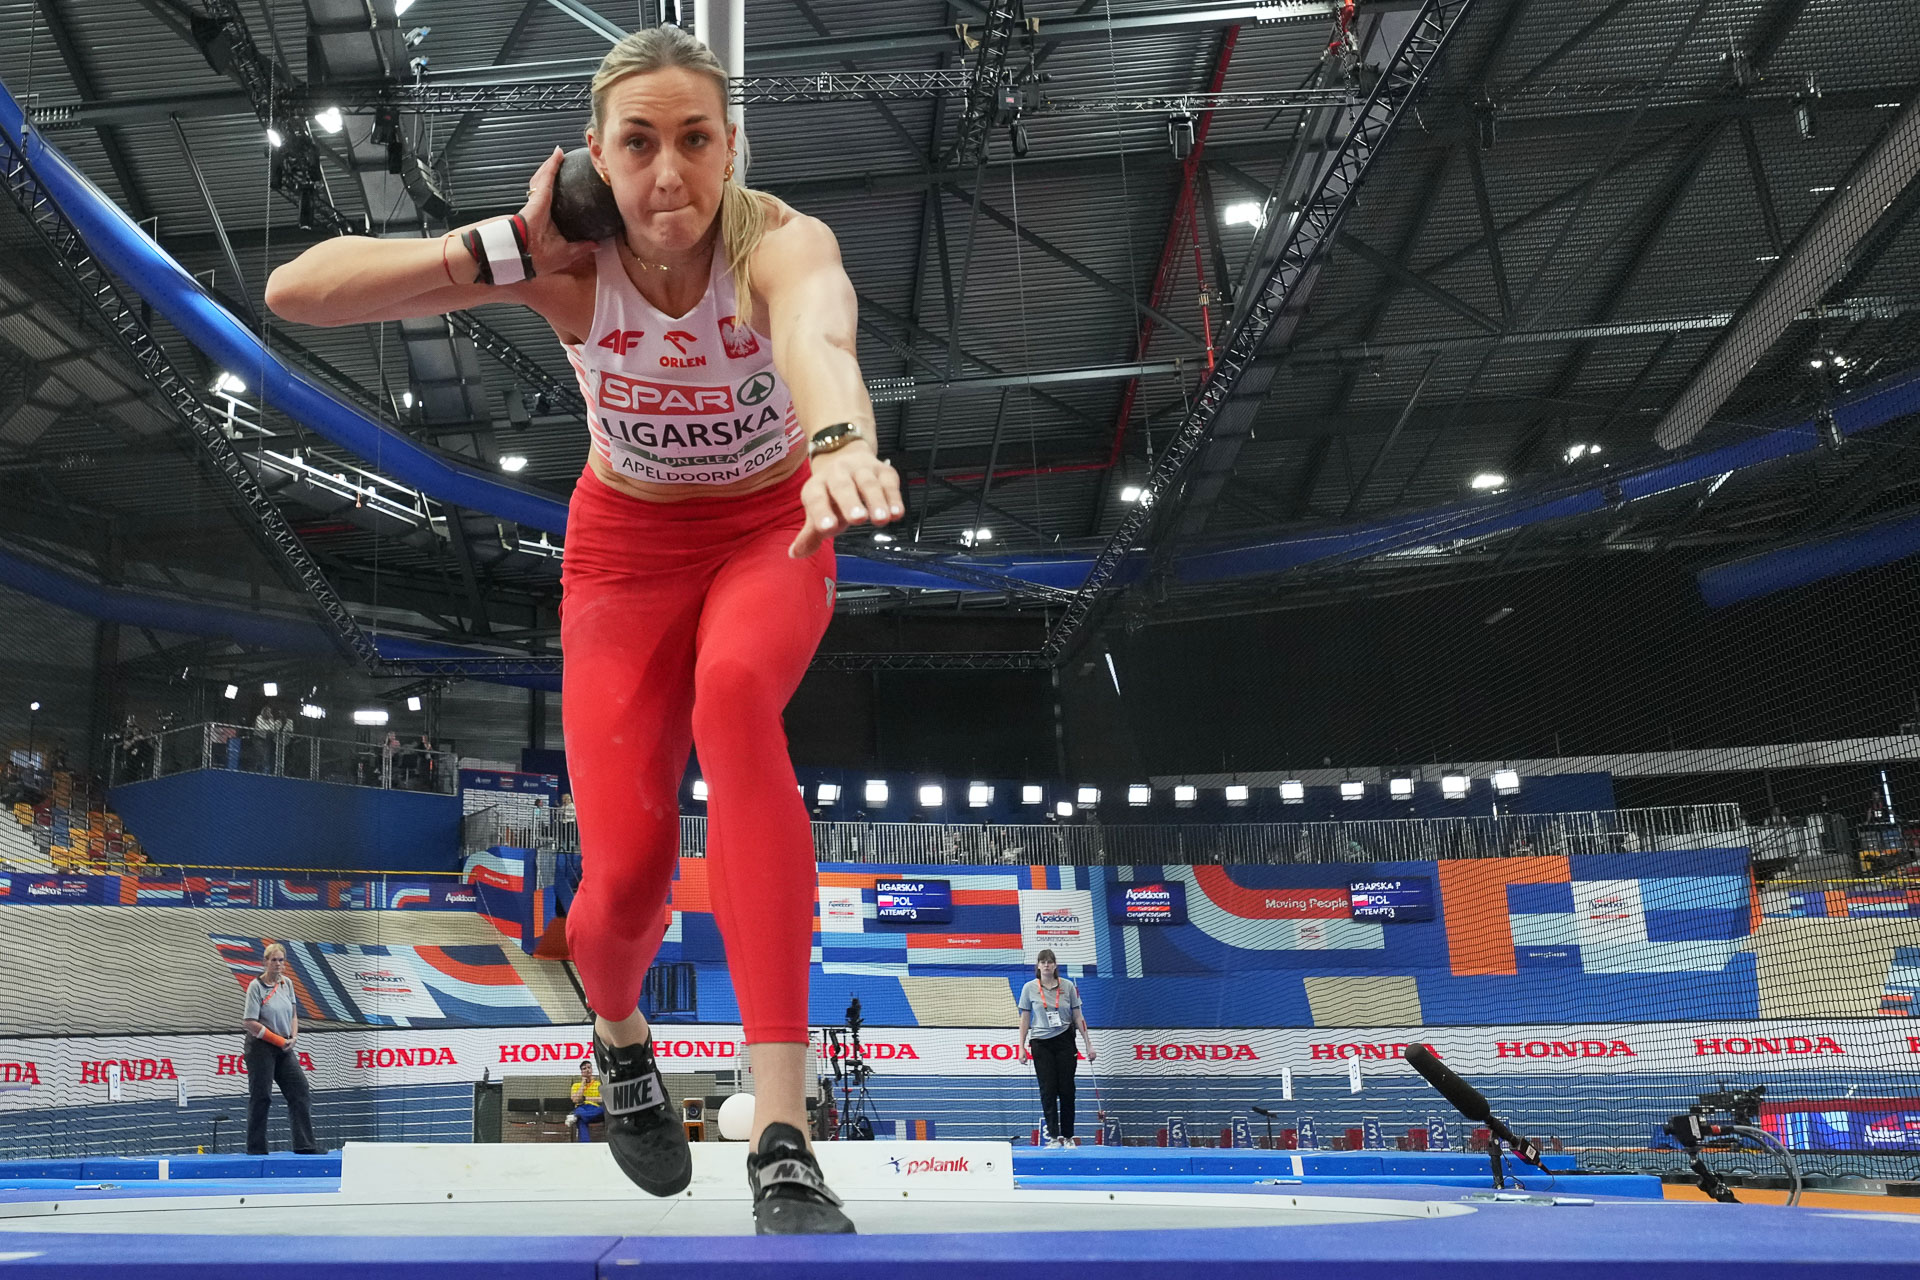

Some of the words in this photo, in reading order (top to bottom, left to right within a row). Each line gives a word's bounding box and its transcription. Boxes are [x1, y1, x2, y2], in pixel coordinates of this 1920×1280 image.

[659, 355, 707, 368] ORLEN
[602, 378, 730, 412] SPAR
[601, 405, 779, 449] LIGARSKA
[622, 457, 740, 482] APELDOORN
[743, 441, 784, 473] 2025
[876, 883, 918, 892] LIGARSKA
[893, 896, 913, 906] POL
[1265, 898, 1307, 912] Moving
[1309, 898, 1348, 912] People
[910, 909, 917, 920] 3
[1134, 1044, 1259, 1061] HONDA
[1495, 1040, 1638, 1059] HONDA
[1692, 1036, 1846, 1056] HONDA
[356, 1047, 458, 1070] HONDA
[79, 1058, 178, 1085] HONDA
[613, 1077, 653, 1111] NIKE
[1105, 1124, 1117, 1139] 7
[1172, 1123, 1183, 1139] 6
[1237, 1123, 1247, 1138] 5
[1300, 1123, 1313, 1138] 4
[1368, 1123, 1378, 1138] 3
[1431, 1123, 1444, 1139] 2
[905, 1156, 969, 1177] polanik
